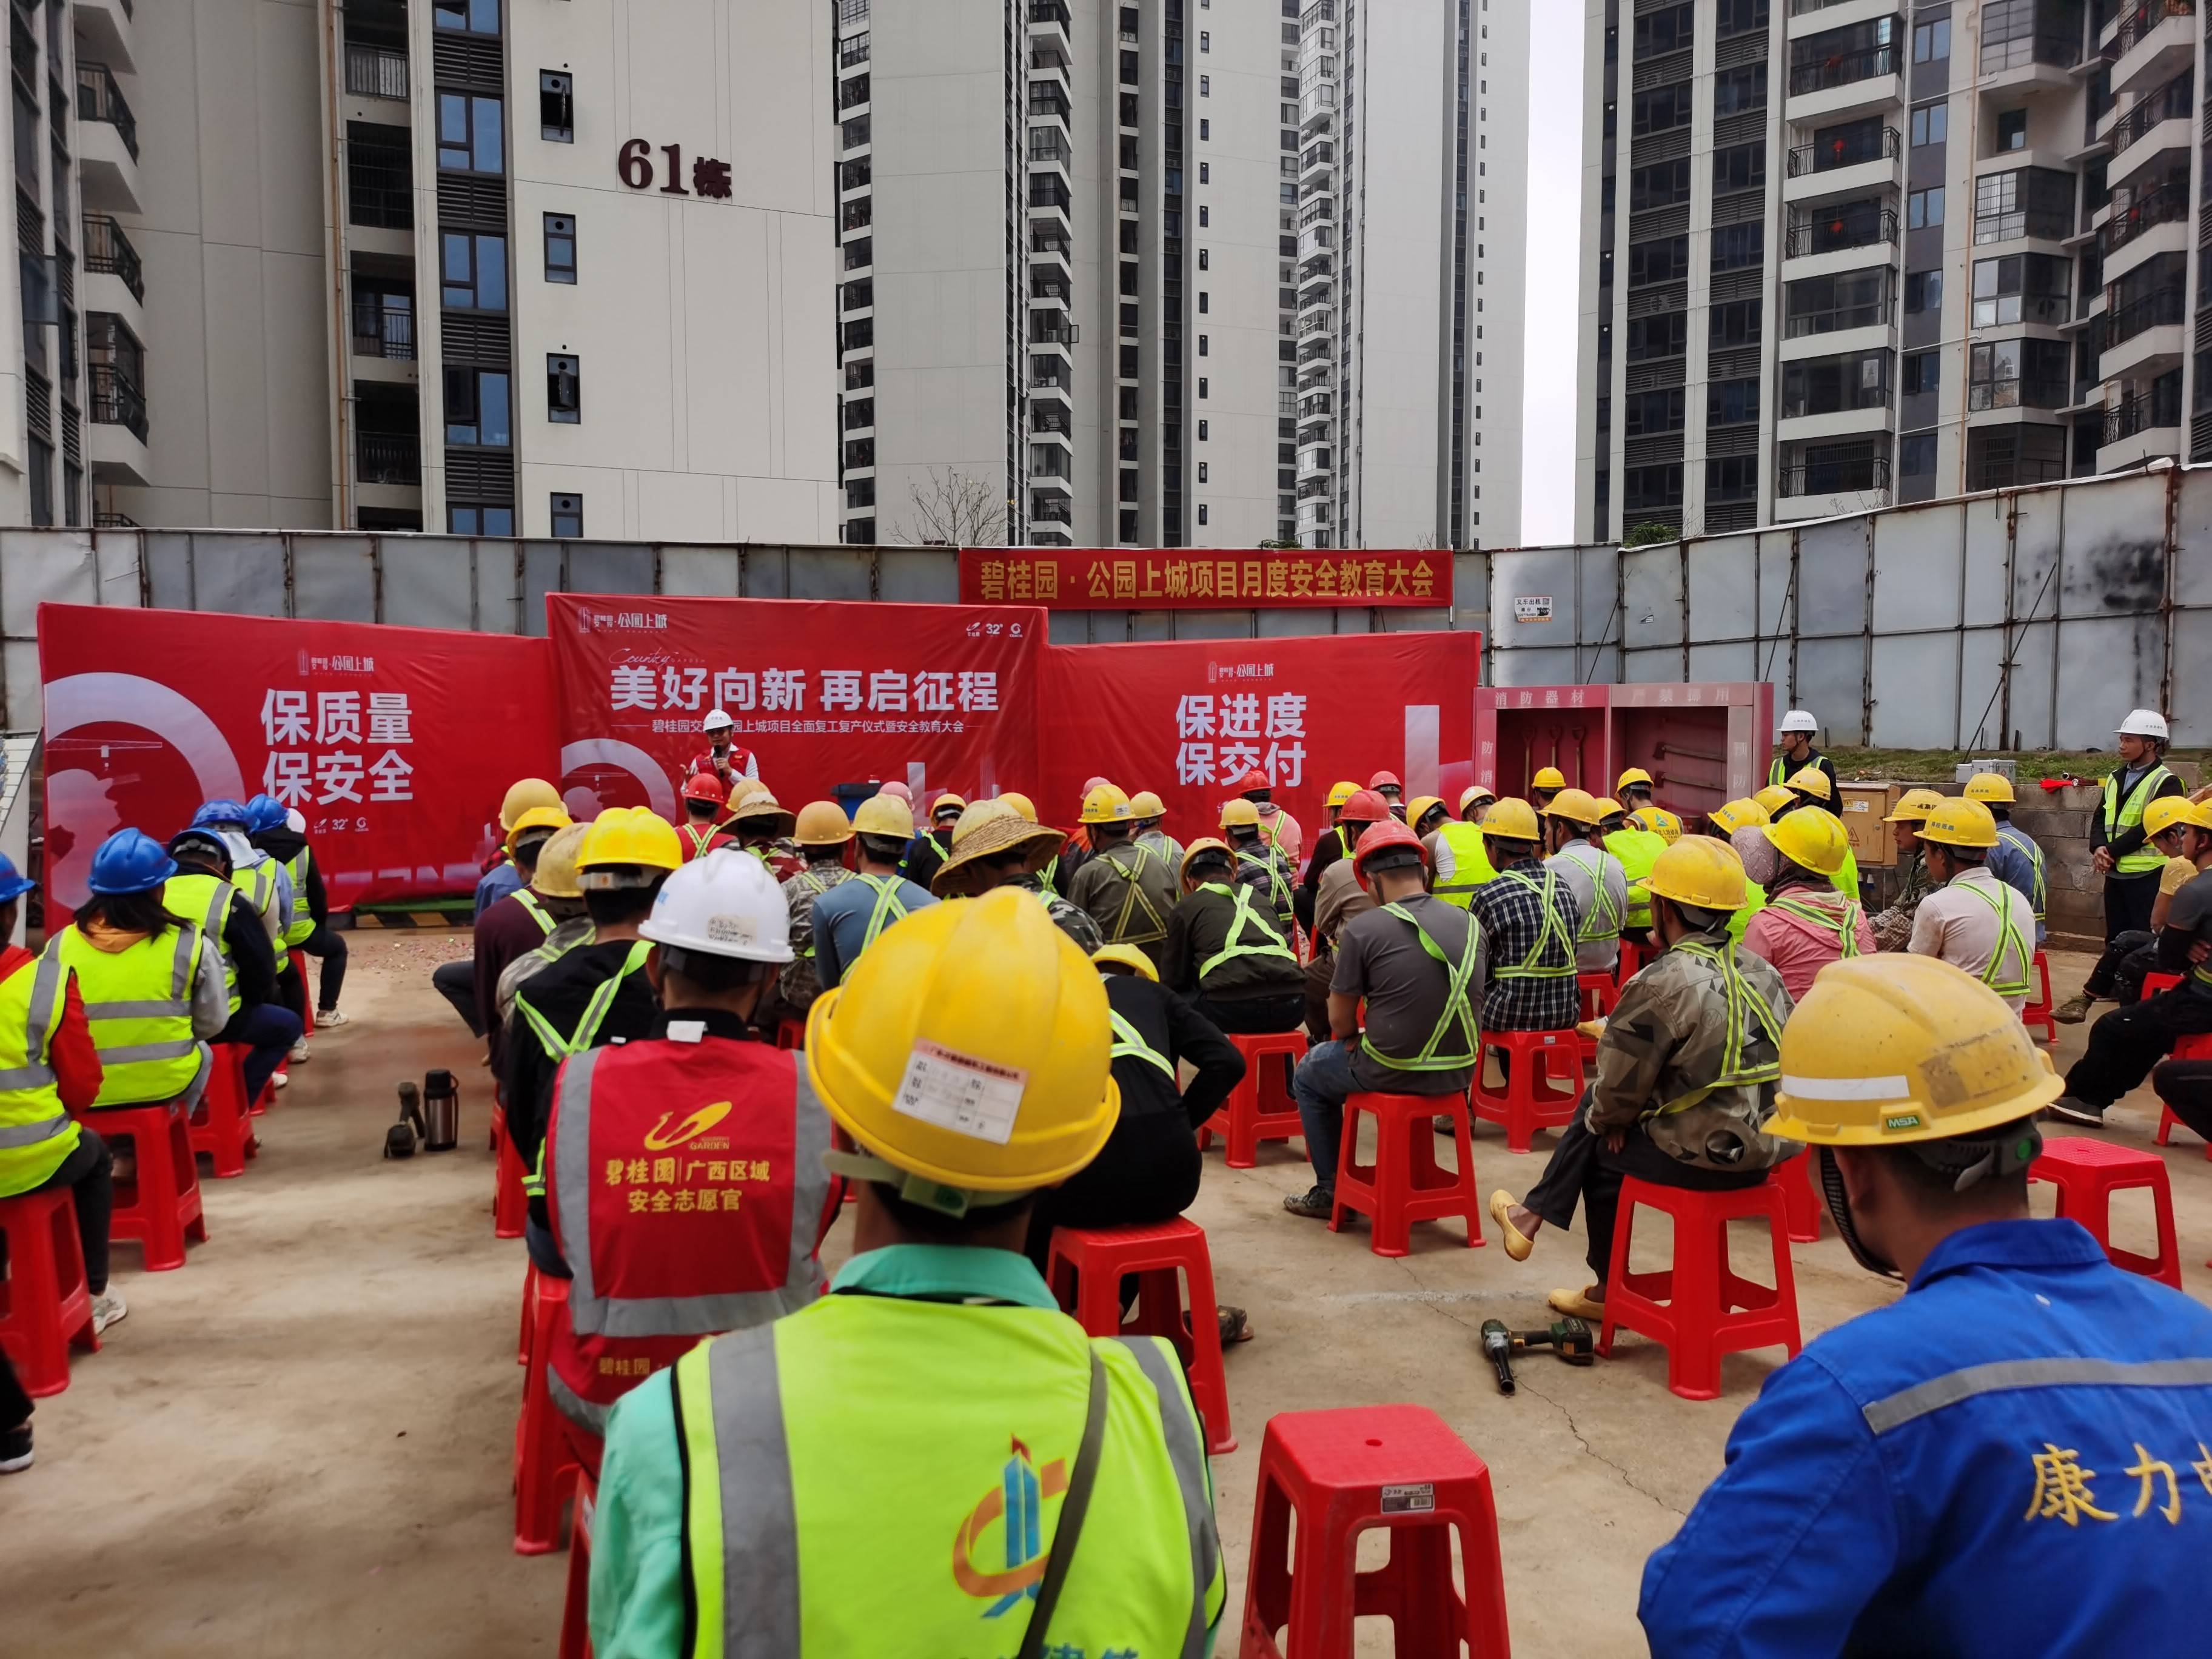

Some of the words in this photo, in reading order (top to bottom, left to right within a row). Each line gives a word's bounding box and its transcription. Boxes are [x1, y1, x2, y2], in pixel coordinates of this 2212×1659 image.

[611, 665, 806, 711] 美好向新
[820, 669, 999, 712] 再启征程
[1495, 689, 1584, 706] 消防器材
[260, 688, 414, 745] 保质量
[1175, 692, 1307, 739] 保进度
[263, 749, 414, 806] 保安全
[1175, 742, 1307, 787] 保交付
[1888, 1116, 1918, 1127] MSA
[686, 1161, 769, 1182] 广西区域
[629, 1189, 742, 1212] 安全志愿官
[2024, 1442, 2212, 1526] 康力
